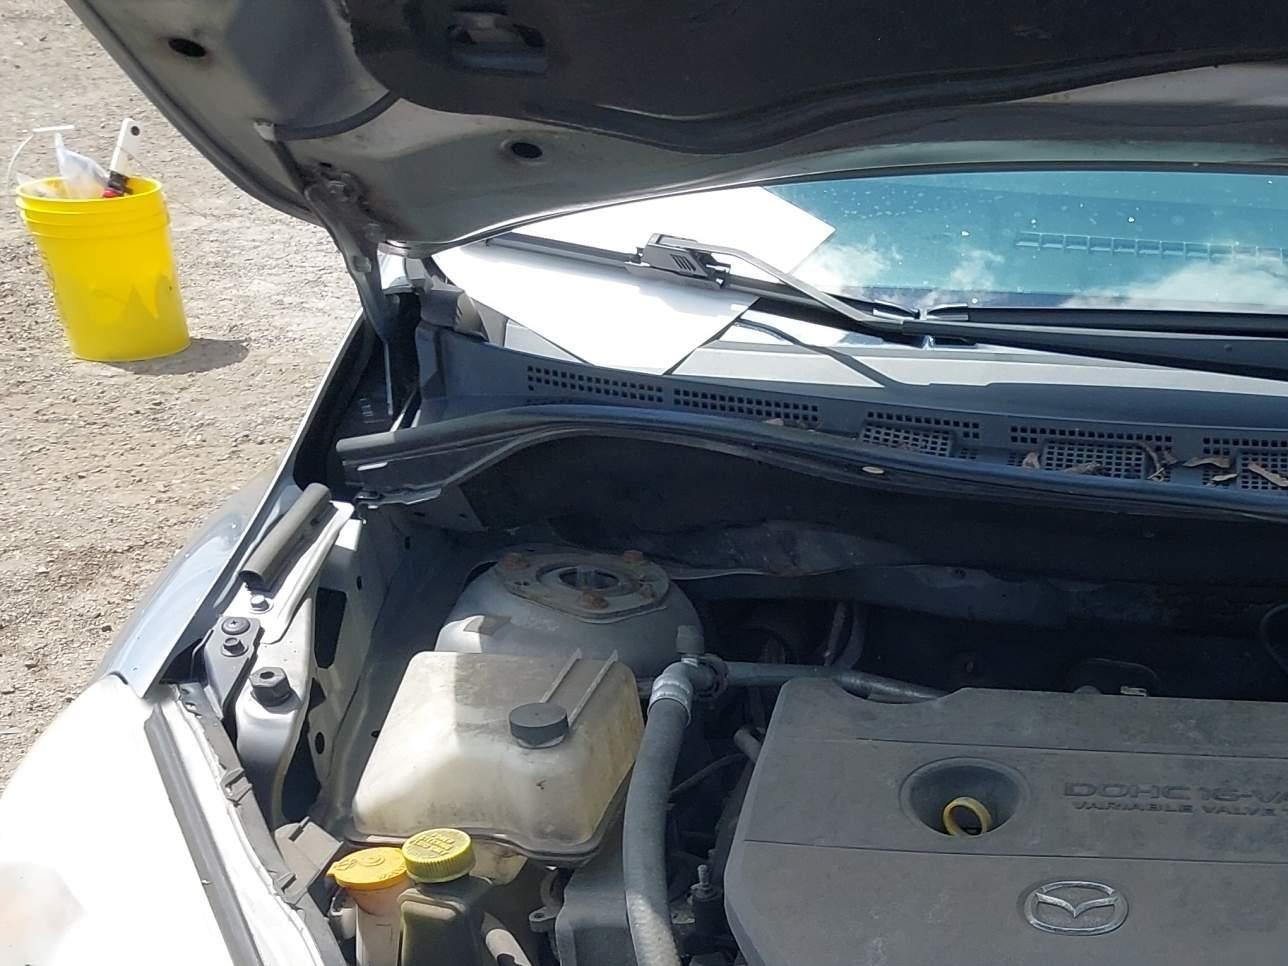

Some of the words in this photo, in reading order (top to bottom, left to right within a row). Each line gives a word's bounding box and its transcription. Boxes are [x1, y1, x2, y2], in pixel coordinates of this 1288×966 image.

[1064, 783, 1191, 800] DOHC
[1072, 800, 1193, 813] VARIABLE
[1201, 805, 1276, 816] VALVE
